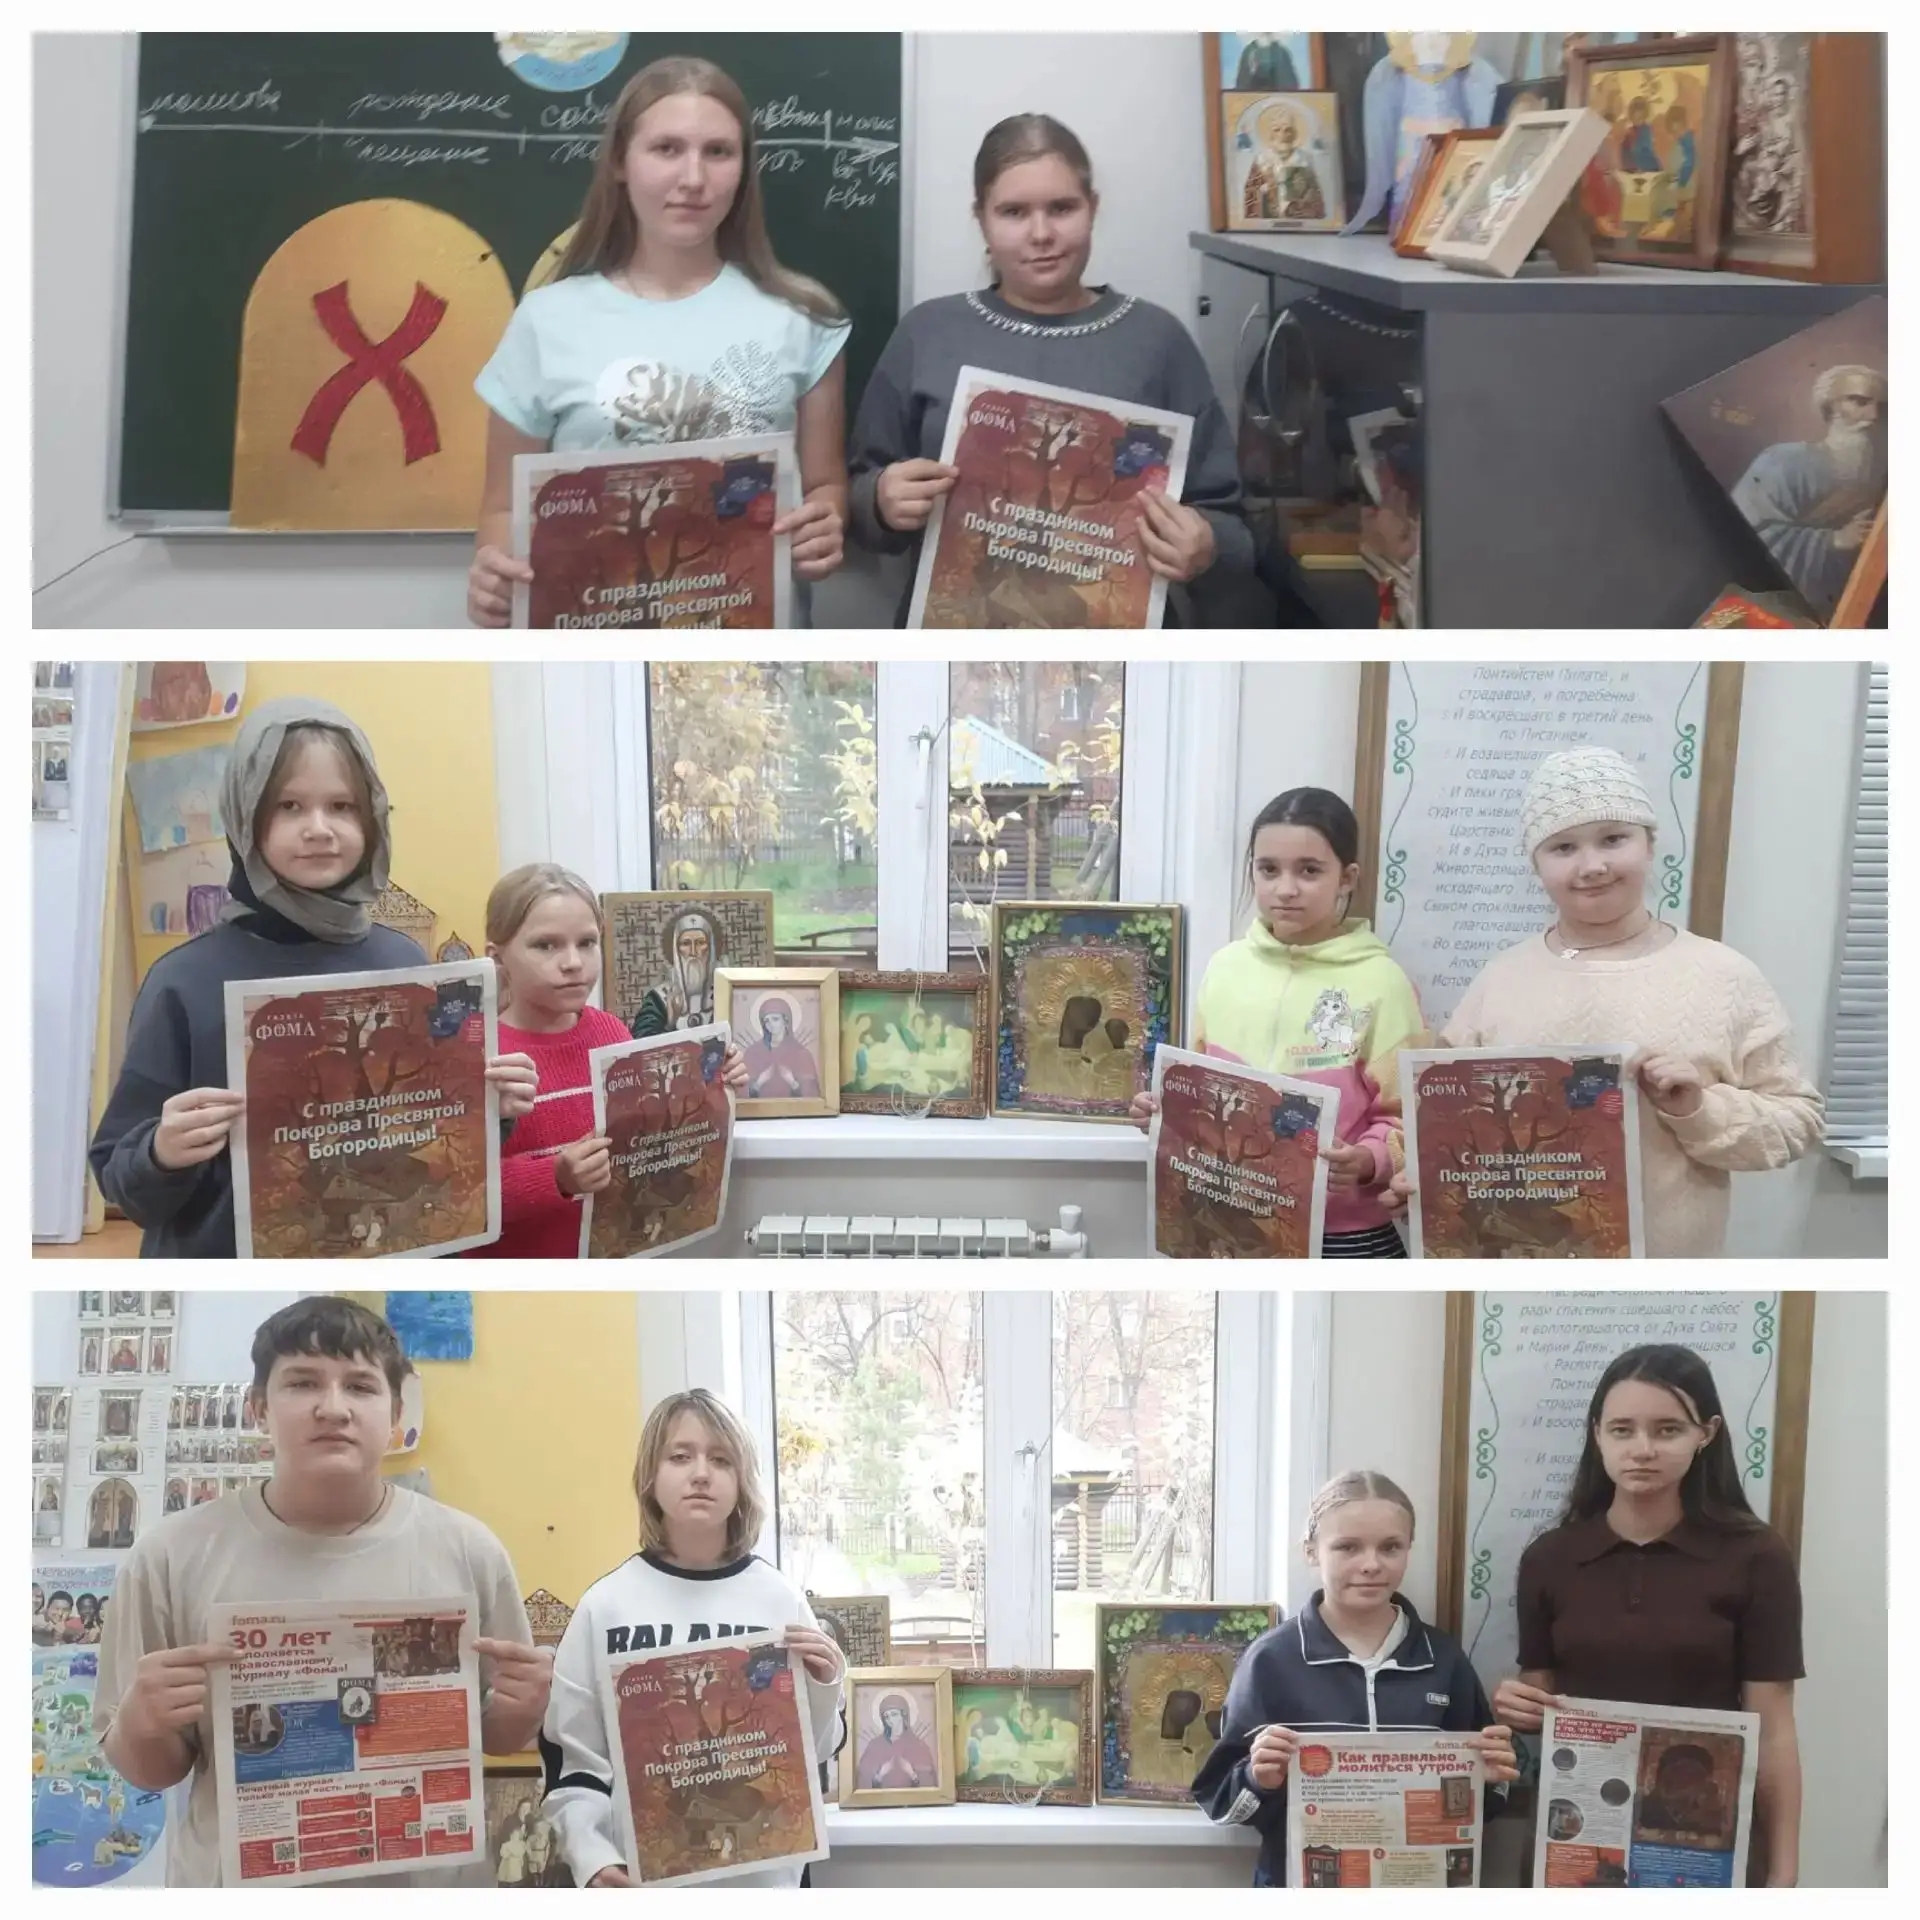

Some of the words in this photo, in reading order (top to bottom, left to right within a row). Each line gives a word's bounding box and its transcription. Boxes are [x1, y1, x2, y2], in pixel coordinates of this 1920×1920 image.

[990, 497, 1000, 513] С
[1004, 500, 1115, 539] праздником
[964, 512, 1038, 545] Покрова
[1042, 532, 1136, 566] Пресвятой
[987, 540, 1105, 581] Богородицы!
[583, 588, 594, 605] С
[601, 573, 727, 606] праздником
[555, 607, 643, 629] Покрова
[650, 589, 752, 619] Пресвятой
[303, 1103, 314, 1119] С
[320, 1088, 441, 1118] праздником
[274, 1119, 361, 1144] Покрова
[367, 1100, 465, 1131] Пресвятой
[630, 1136, 639, 1147] С
[640, 1120, 709, 1146] праздником
[309, 1124, 437, 1160] Богородицы!
[611, 1148, 662, 1167] Покрова
[664, 1131, 720, 1155] Пресвятой
[629, 1148, 704, 1178] Богородицы!
[1188, 1147, 1196, 1159] С
[1197, 1151, 1277, 1187] праздником
[1440, 1170, 1511, 1185] Покрова
[1516, 1167, 1606, 1184] Пресвятой
[1461, 1152, 1470, 1165] С
[1475, 1152, 1581, 1170] праздником
[1169, 1156, 1220, 1185] Покрова
[1224, 1177, 1295, 1208] Пресвятой
[1467, 1185, 1580, 1201] Богородицы!
[1187, 1179, 1272, 1217] Богородицы!
[229, 1629, 267, 1650] 30
[279, 1632, 331, 1647] лет
[230, 1657, 333, 1671] православному
[231, 1670, 289, 1682] журналу
[663, 1743, 671, 1756] С
[675, 1730, 766, 1755] праздником
[1338, 1752, 1366, 1763] Как
[1372, 1753, 1456, 1765] правильно
[645, 1756, 708, 1777] Покрова
[712, 1741, 787, 1765] Пресвятой
[672, 1761, 767, 1788] Богородицы!
[1338, 1763, 1414, 1773] молиться
[1418, 1761, 1475, 1775] утром?
